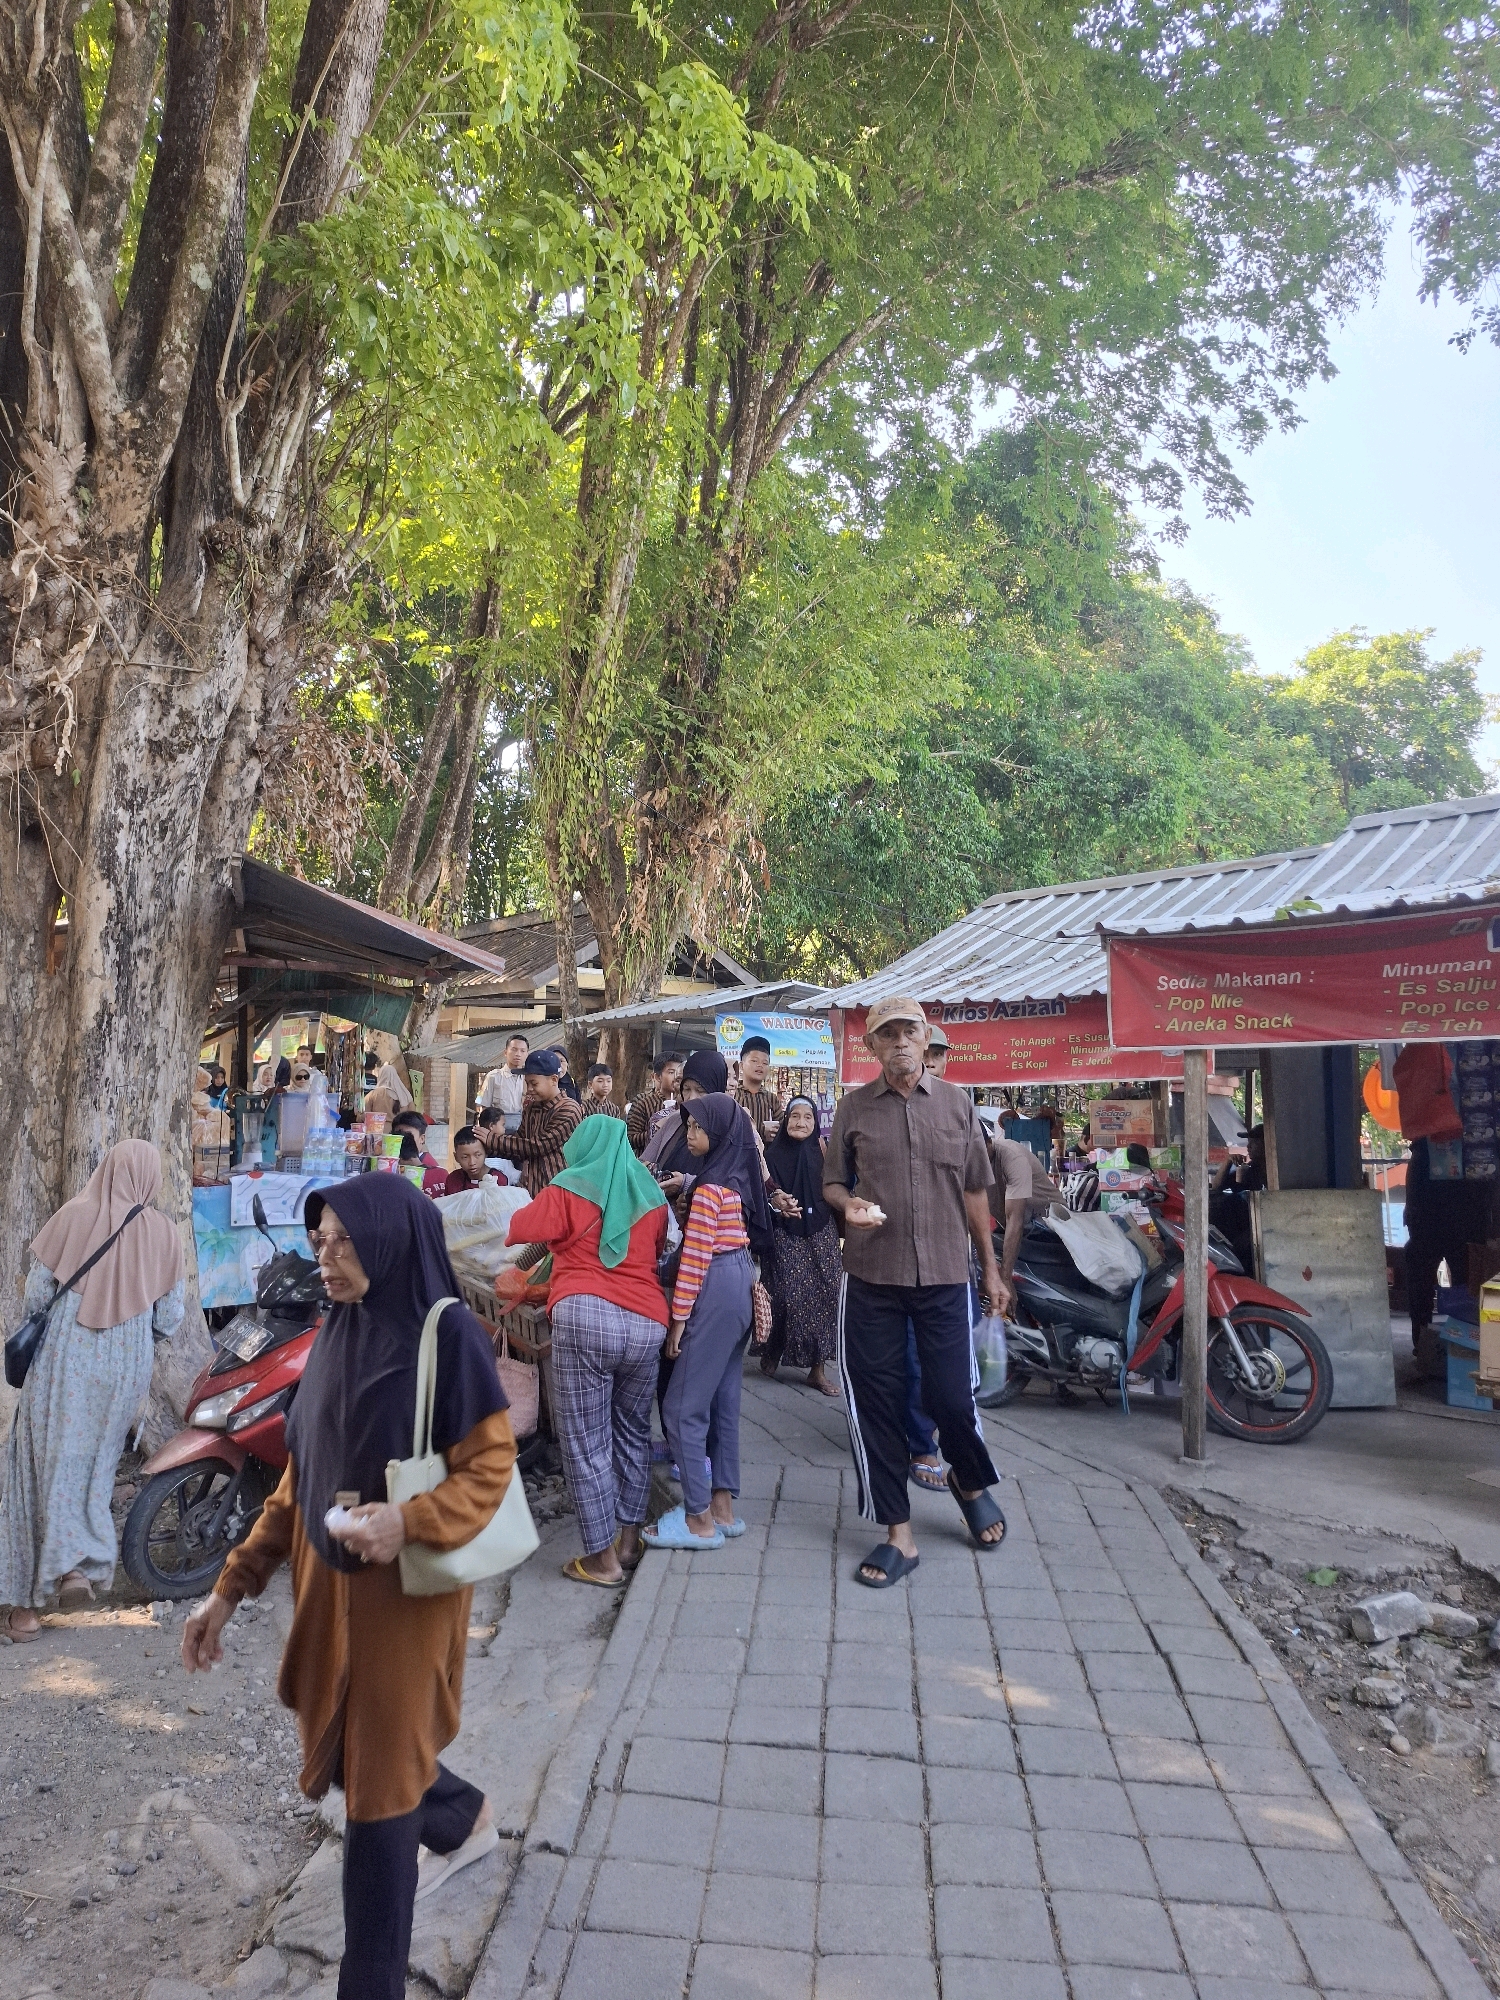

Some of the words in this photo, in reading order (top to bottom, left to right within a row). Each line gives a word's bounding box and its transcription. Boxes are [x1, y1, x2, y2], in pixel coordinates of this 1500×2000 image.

[1382, 959, 1492, 978] Minuman
[1157, 974, 1207, 991] Sedia
[1214, 971, 1301, 989] Makanan
[1398, 981, 1428, 996] Es
[1436, 976, 1497, 995] Salju
[1168, 996, 1205, 1013] Pop
[1211, 993, 1244, 1009] Mie
[1399, 1001, 1447, 1017] Pop
[1454, 999, 1490, 1013] Ice
[760, 1017, 825, 1031] WARUNG
[1165, 1016, 1227, 1032] Aneka
[1234, 1012, 1295, 1030] Snack
[1400, 1020, 1431, 1034] Es
[1441, 1017, 1483, 1031] Teh
[1010, 1038, 1026, 1047] Teh
[1028, 1036, 1056, 1048] Anget
[1068, 1034, 1081, 1043] Es
[1084, 1033, 1110, 1042] Susu
[852, 1044, 867, 1053] Pop
[1010, 1049, 1031, 1059] Kopi
[851, 1055, 876, 1063] Aneka
[948, 1054, 974, 1062] Aneka
[975, 1053, 998, 1061] Rasa
[1071, 1057, 1083, 1066] Es
[1086, 1056, 1113, 1066] Jeruk
[1011, 1061, 1024, 1070] Es
[1026, 1060, 1048, 1070] Kopi
